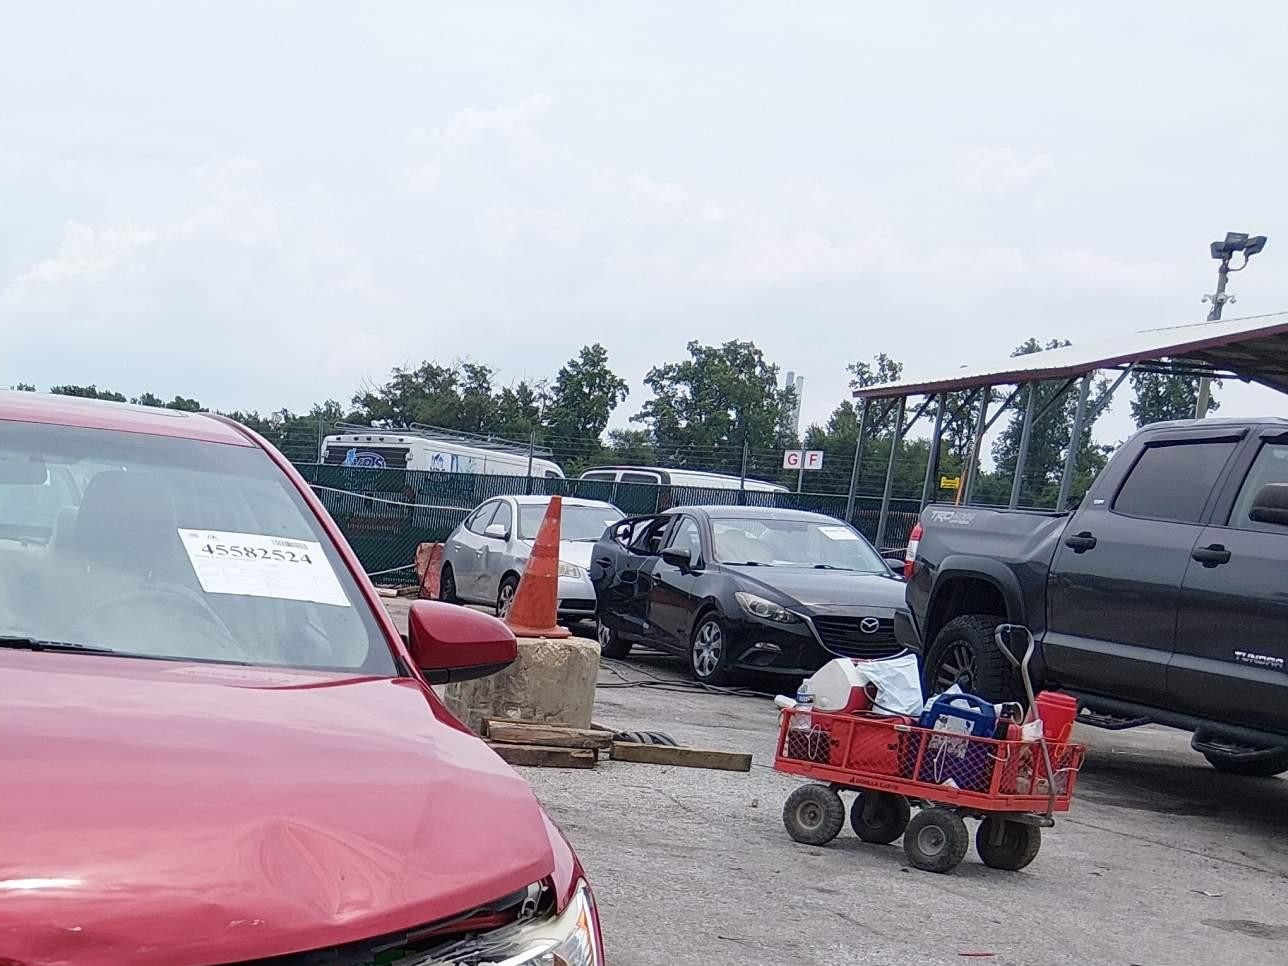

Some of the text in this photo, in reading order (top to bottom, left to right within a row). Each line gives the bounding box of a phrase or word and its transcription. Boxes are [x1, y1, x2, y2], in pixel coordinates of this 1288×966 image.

[787, 453, 798, 466] G
[808, 453, 818, 466] F
[201, 543, 313, 565] 45582524
[1234, 651, 1284, 668] TUNDRA
